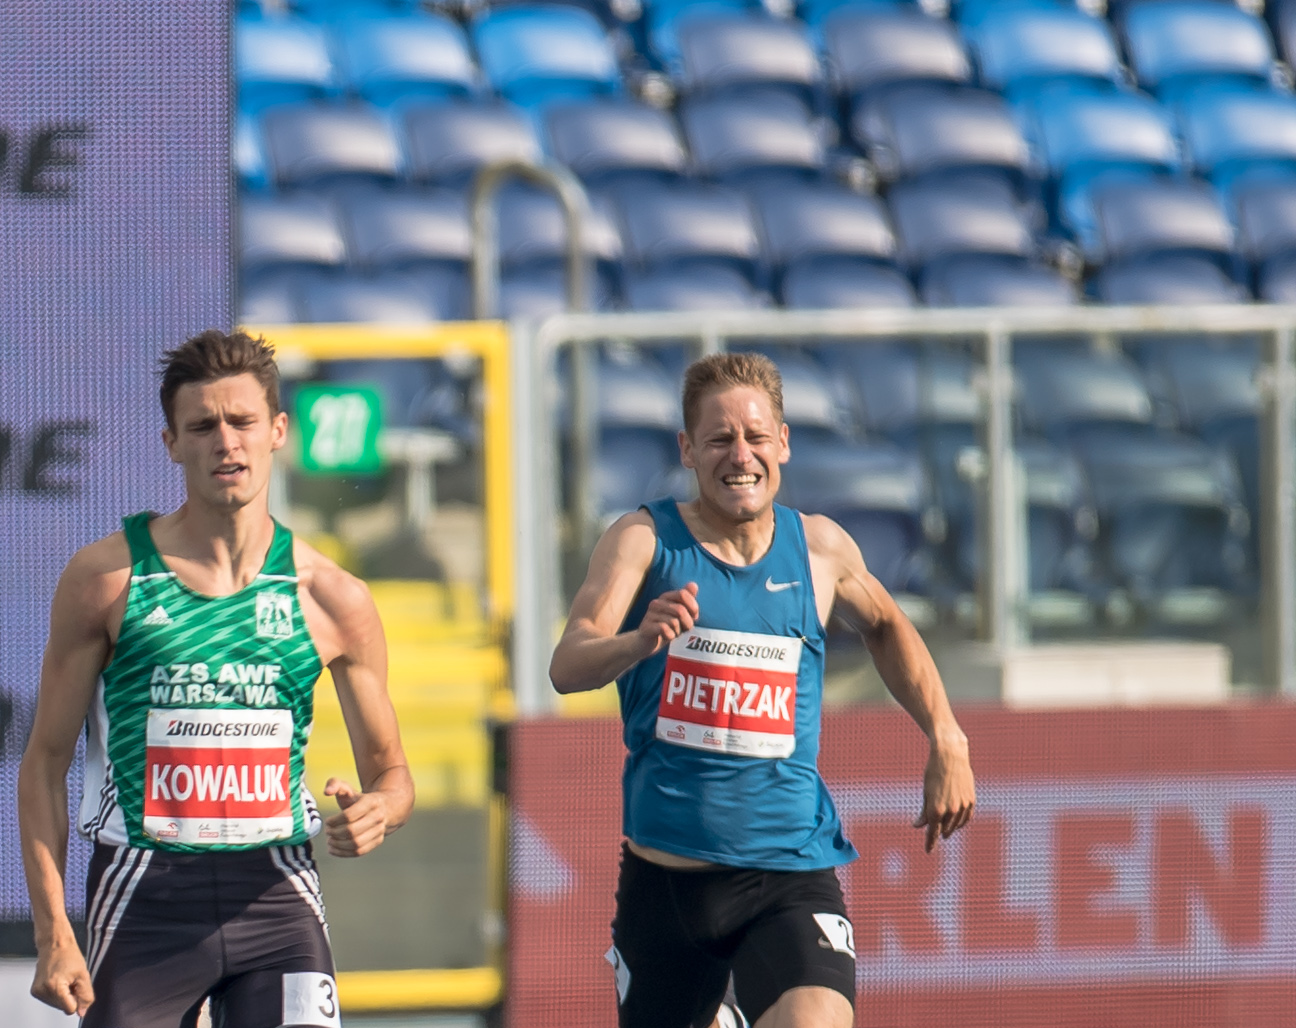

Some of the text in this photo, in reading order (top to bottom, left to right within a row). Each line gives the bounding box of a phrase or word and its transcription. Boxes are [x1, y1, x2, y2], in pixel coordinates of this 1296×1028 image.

[686, 636, 787, 661] BRIDGESTONE
[150, 663, 282, 684] AZS AWF
[149, 684, 279, 704] WARSZAWA
[667, 671, 792, 721] PIETRZAK
[166, 720, 280, 736] BRIDGESTONE
[151, 763, 286, 802] KOWALUK
[854, 808, 1272, 958] RLEN
[319, 979, 335, 1018] 3
